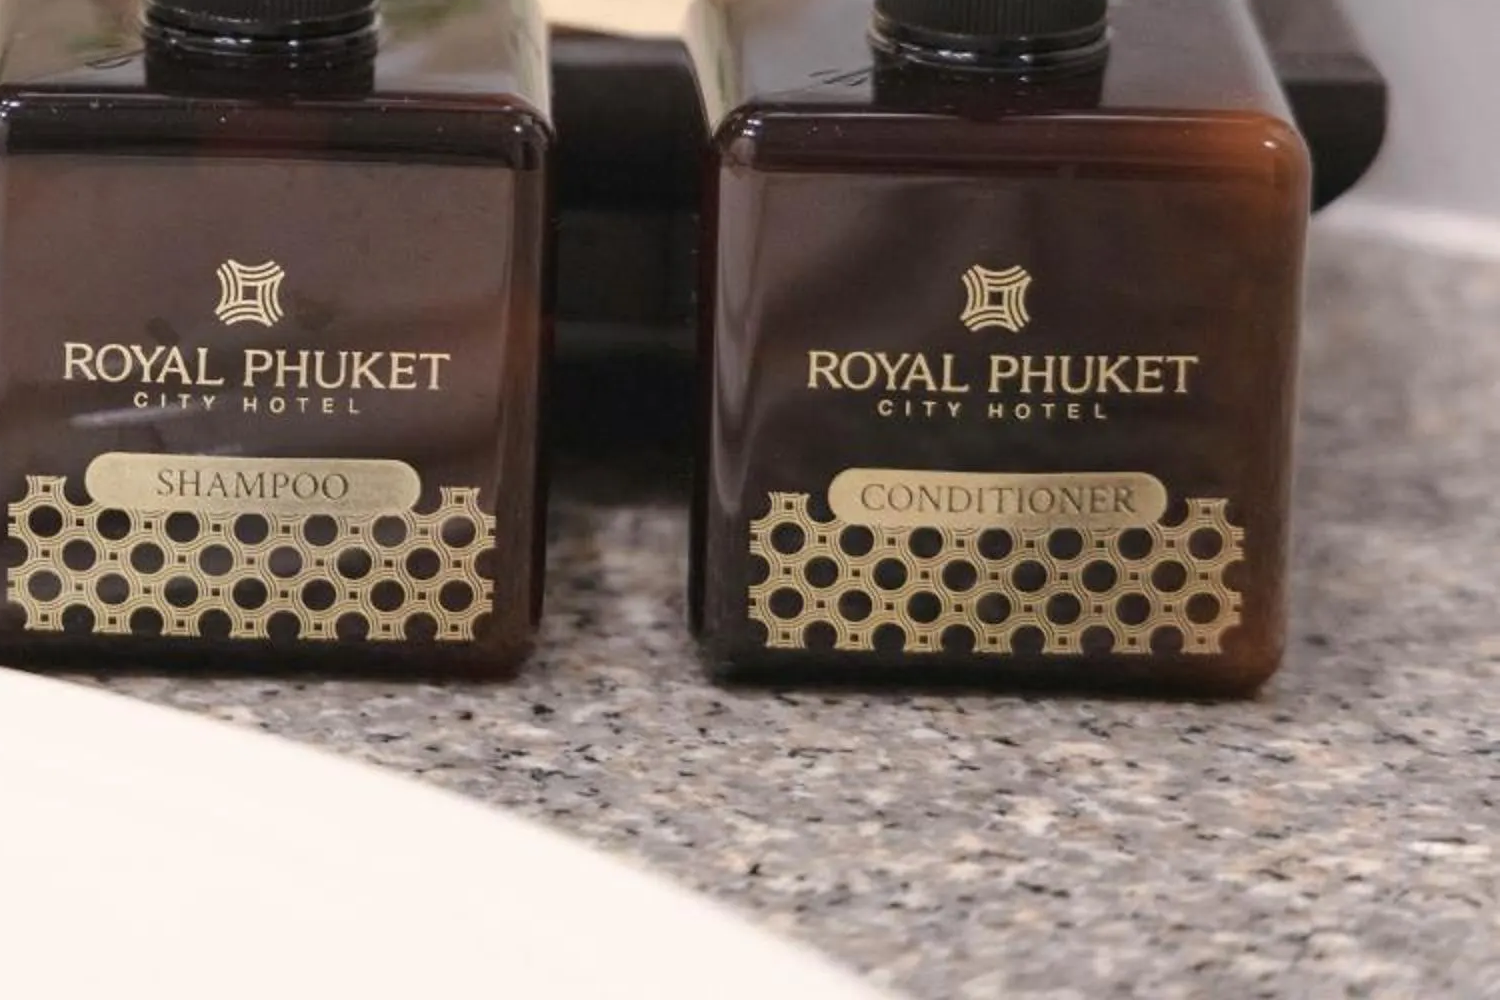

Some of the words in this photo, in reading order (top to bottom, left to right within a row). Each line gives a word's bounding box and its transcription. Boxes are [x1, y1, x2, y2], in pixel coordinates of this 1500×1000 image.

[62, 341, 225, 387] ROYAL
[242, 347, 452, 391] PHUKET
[806, 349, 969, 393] ROYAL
[987, 354, 1199, 395] PHUKET
[133, 390, 217, 410] CITY
[242, 395, 361, 415] HOTEL
[877, 399, 963, 418] CITY
[987, 402, 1108, 421] HOTEL
[155, 468, 350, 500] SHAMPOO
[860, 482, 1138, 516] CONDITIONER
